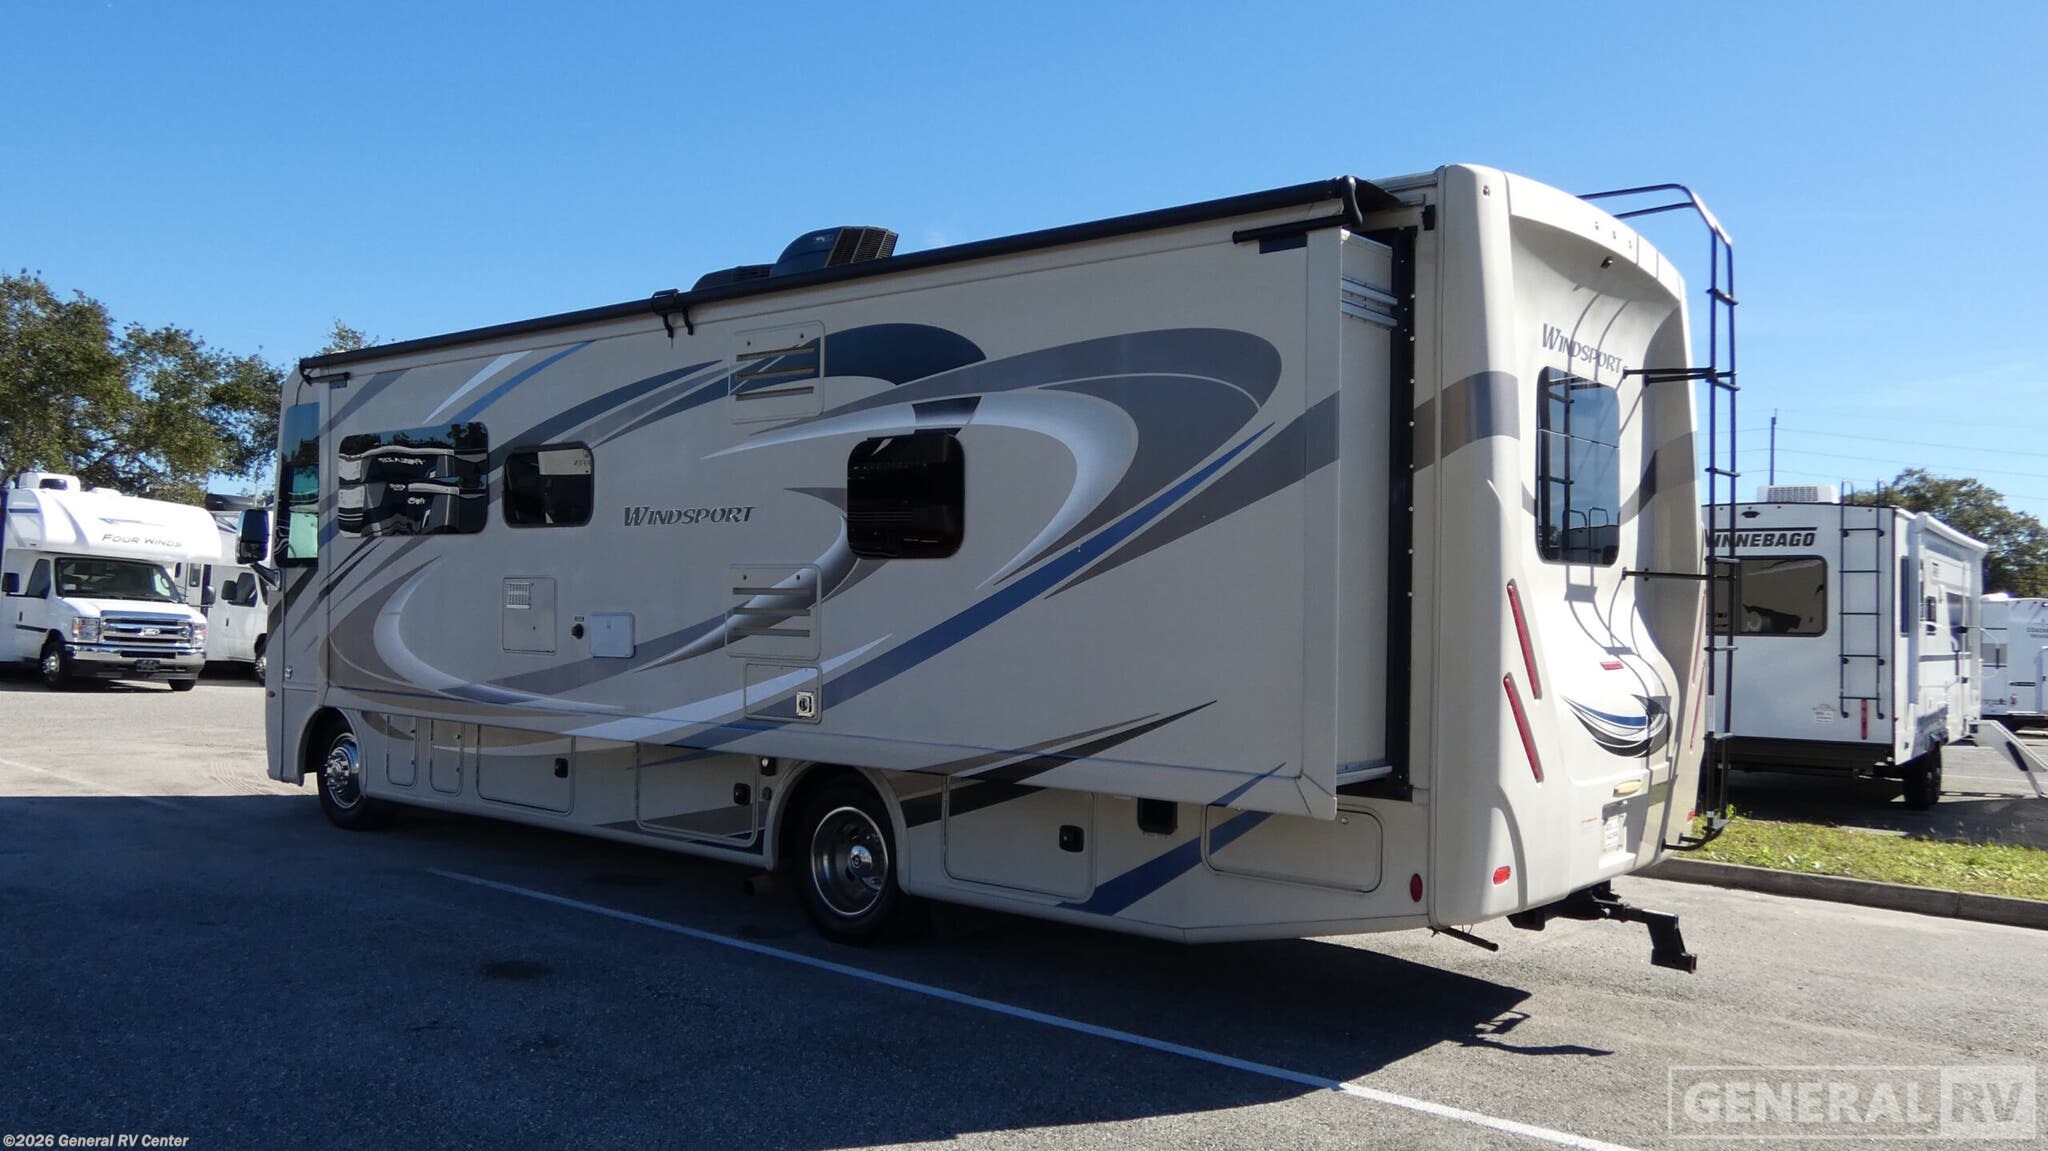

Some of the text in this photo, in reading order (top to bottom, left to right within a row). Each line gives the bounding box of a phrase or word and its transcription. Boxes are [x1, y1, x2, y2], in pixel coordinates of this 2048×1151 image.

[1543, 323, 1622, 373] WINDSPORT
[624, 506, 757, 526] WINDSPORT
[102, 533, 183, 548] FOUR WINDS
